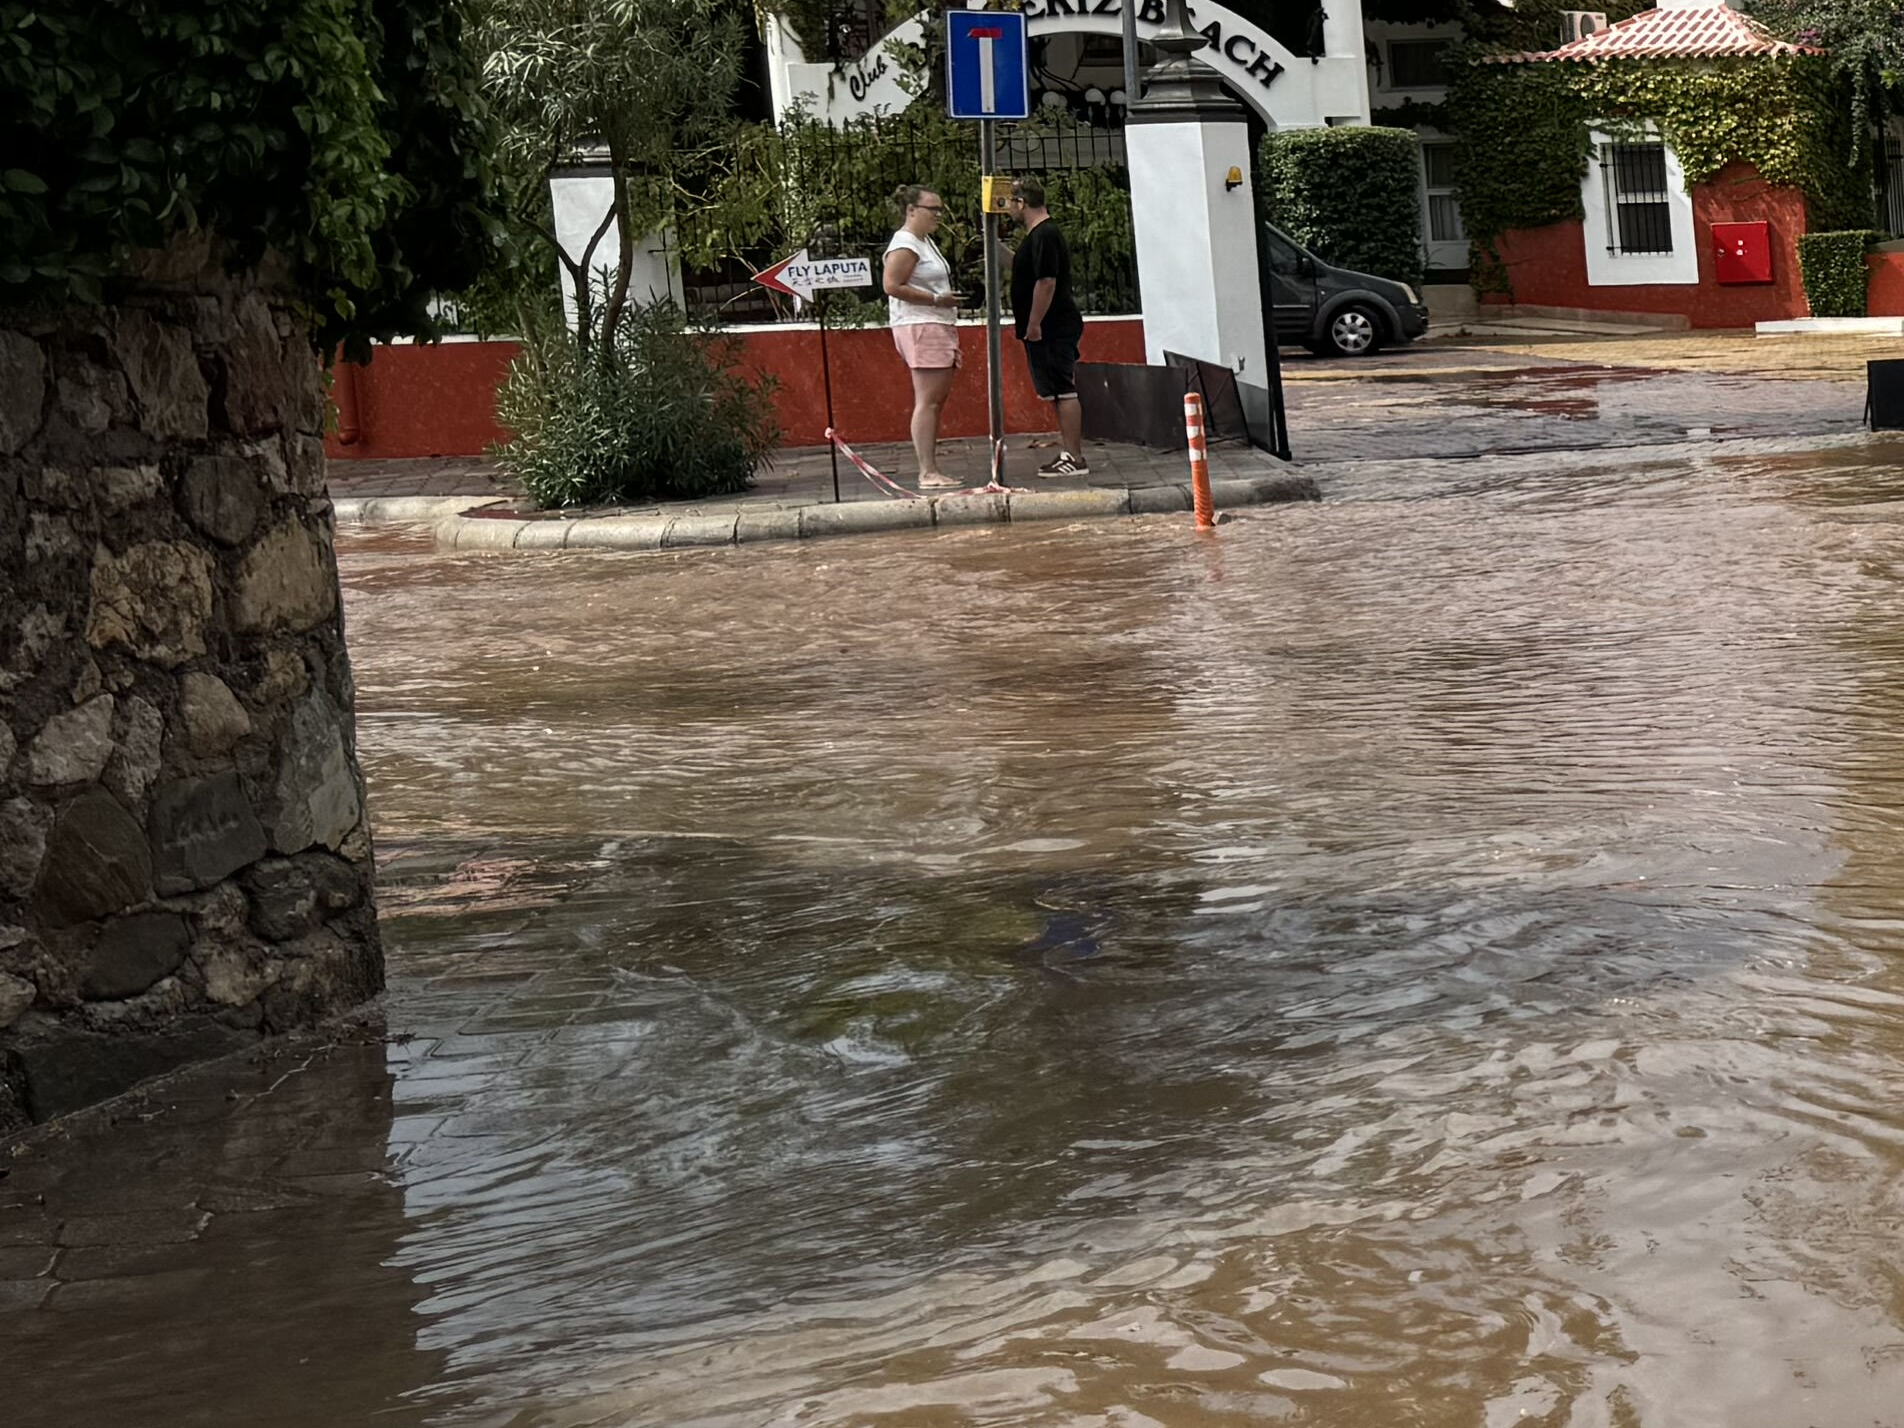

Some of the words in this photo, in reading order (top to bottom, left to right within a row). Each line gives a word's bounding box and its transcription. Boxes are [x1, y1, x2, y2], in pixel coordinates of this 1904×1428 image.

[849, 54, 888, 101] Club
[788, 265, 811, 278] FLY
[814, 261, 868, 276] LAPUTA
